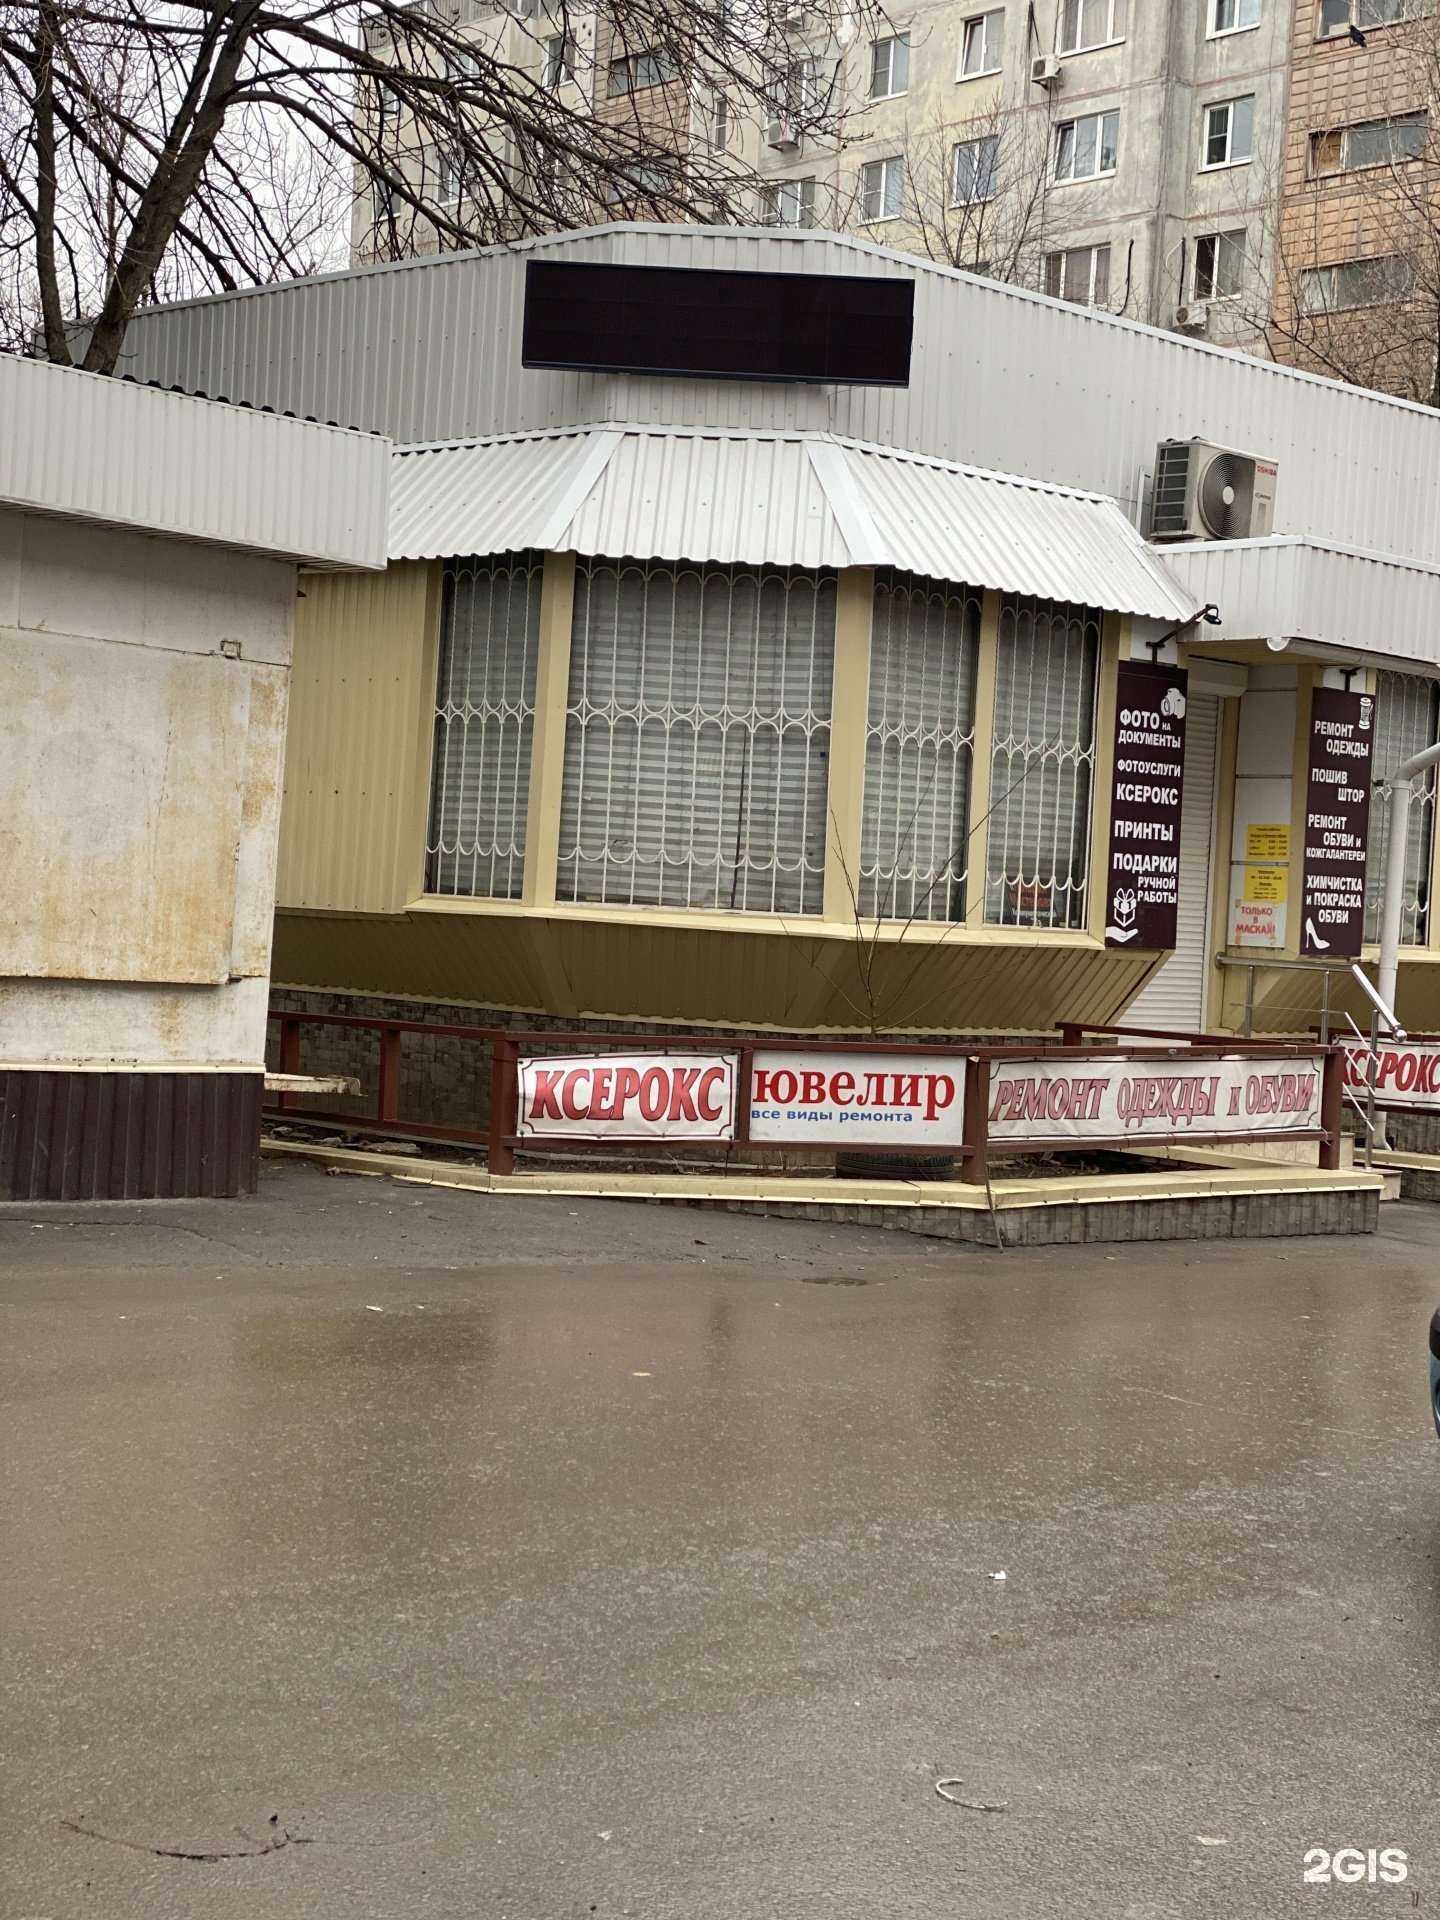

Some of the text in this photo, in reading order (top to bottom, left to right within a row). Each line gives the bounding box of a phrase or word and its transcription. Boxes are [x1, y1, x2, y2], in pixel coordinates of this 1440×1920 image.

[1120, 709, 1171, 731] ФОТО НА
[1314, 720, 1354, 738] РЕМОНТ
[1118, 730, 1181, 748] ДОКУМЕНТЫ
[1326, 739, 1369, 758] ОДЕЖДЫ
[1117, 759, 1181, 777] ФОТОУСЛУГИ
[1312, 768, 1348, 784] ПОШИВ
[1116, 783, 1179, 805] КСЕРОКС
[1337, 787, 1365, 802] ШТОР
[1307, 813, 1347, 830] РЕМОНТ
[1114, 820, 1174, 841] ПРИНТЫ
[1323, 832, 1354, 847] ОБУВИ
[1306, 847, 1366, 861] КОЖГАЛАНТЕРЕИ
[1113, 853, 1178, 874] ПОДАРКИ
[1137, 876, 1176, 890] РУЧНОЙ
[1306, 875, 1363, 891] ХИМЧИСТКА
[1137, 891, 1177, 904] РАБОТЫ
[1313, 892, 1362, 908] ПОКРАСКА
[1241, 905, 1273, 916] ТОЛЬКО
[1318, 909, 1349, 924] ОБУВИ
[529, 1067, 725, 1122] КСЕРОКС
[988, 1078, 1111, 1122] РЕМОНТ
[1116, 1077, 1222, 1128] ОДЕЖДЫ
[1245, 1074, 1316, 1116] ОБУВИ
[751, 1110, 913, 1123] все виды ремонта
